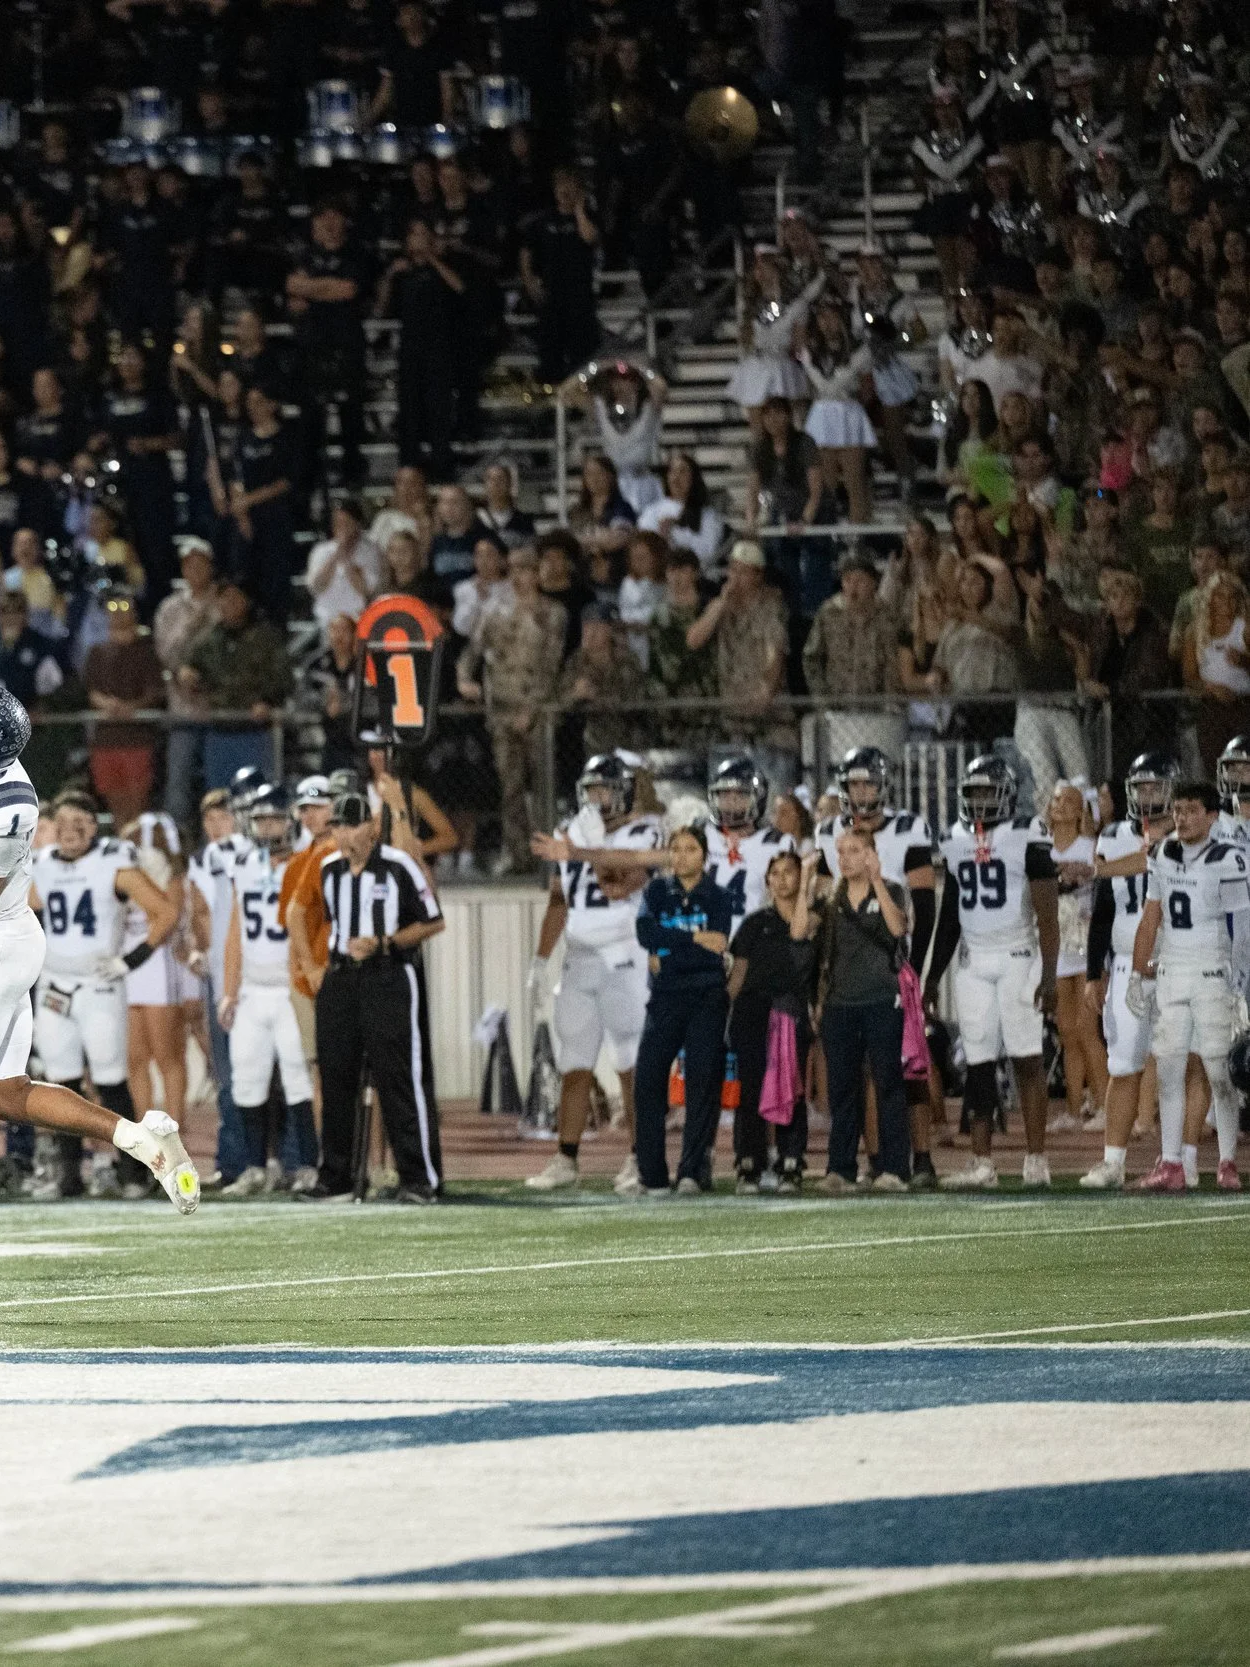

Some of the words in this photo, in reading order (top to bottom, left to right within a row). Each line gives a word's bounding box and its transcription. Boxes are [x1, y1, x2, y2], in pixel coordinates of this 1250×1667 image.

[387, 653, 424, 727] 1
[7, 813, 20, 836] 1
[567, 861, 609, 908] 72
[709, 864, 747, 916] 4
[958, 860, 1006, 911] 99
[48, 889, 96, 936] 84
